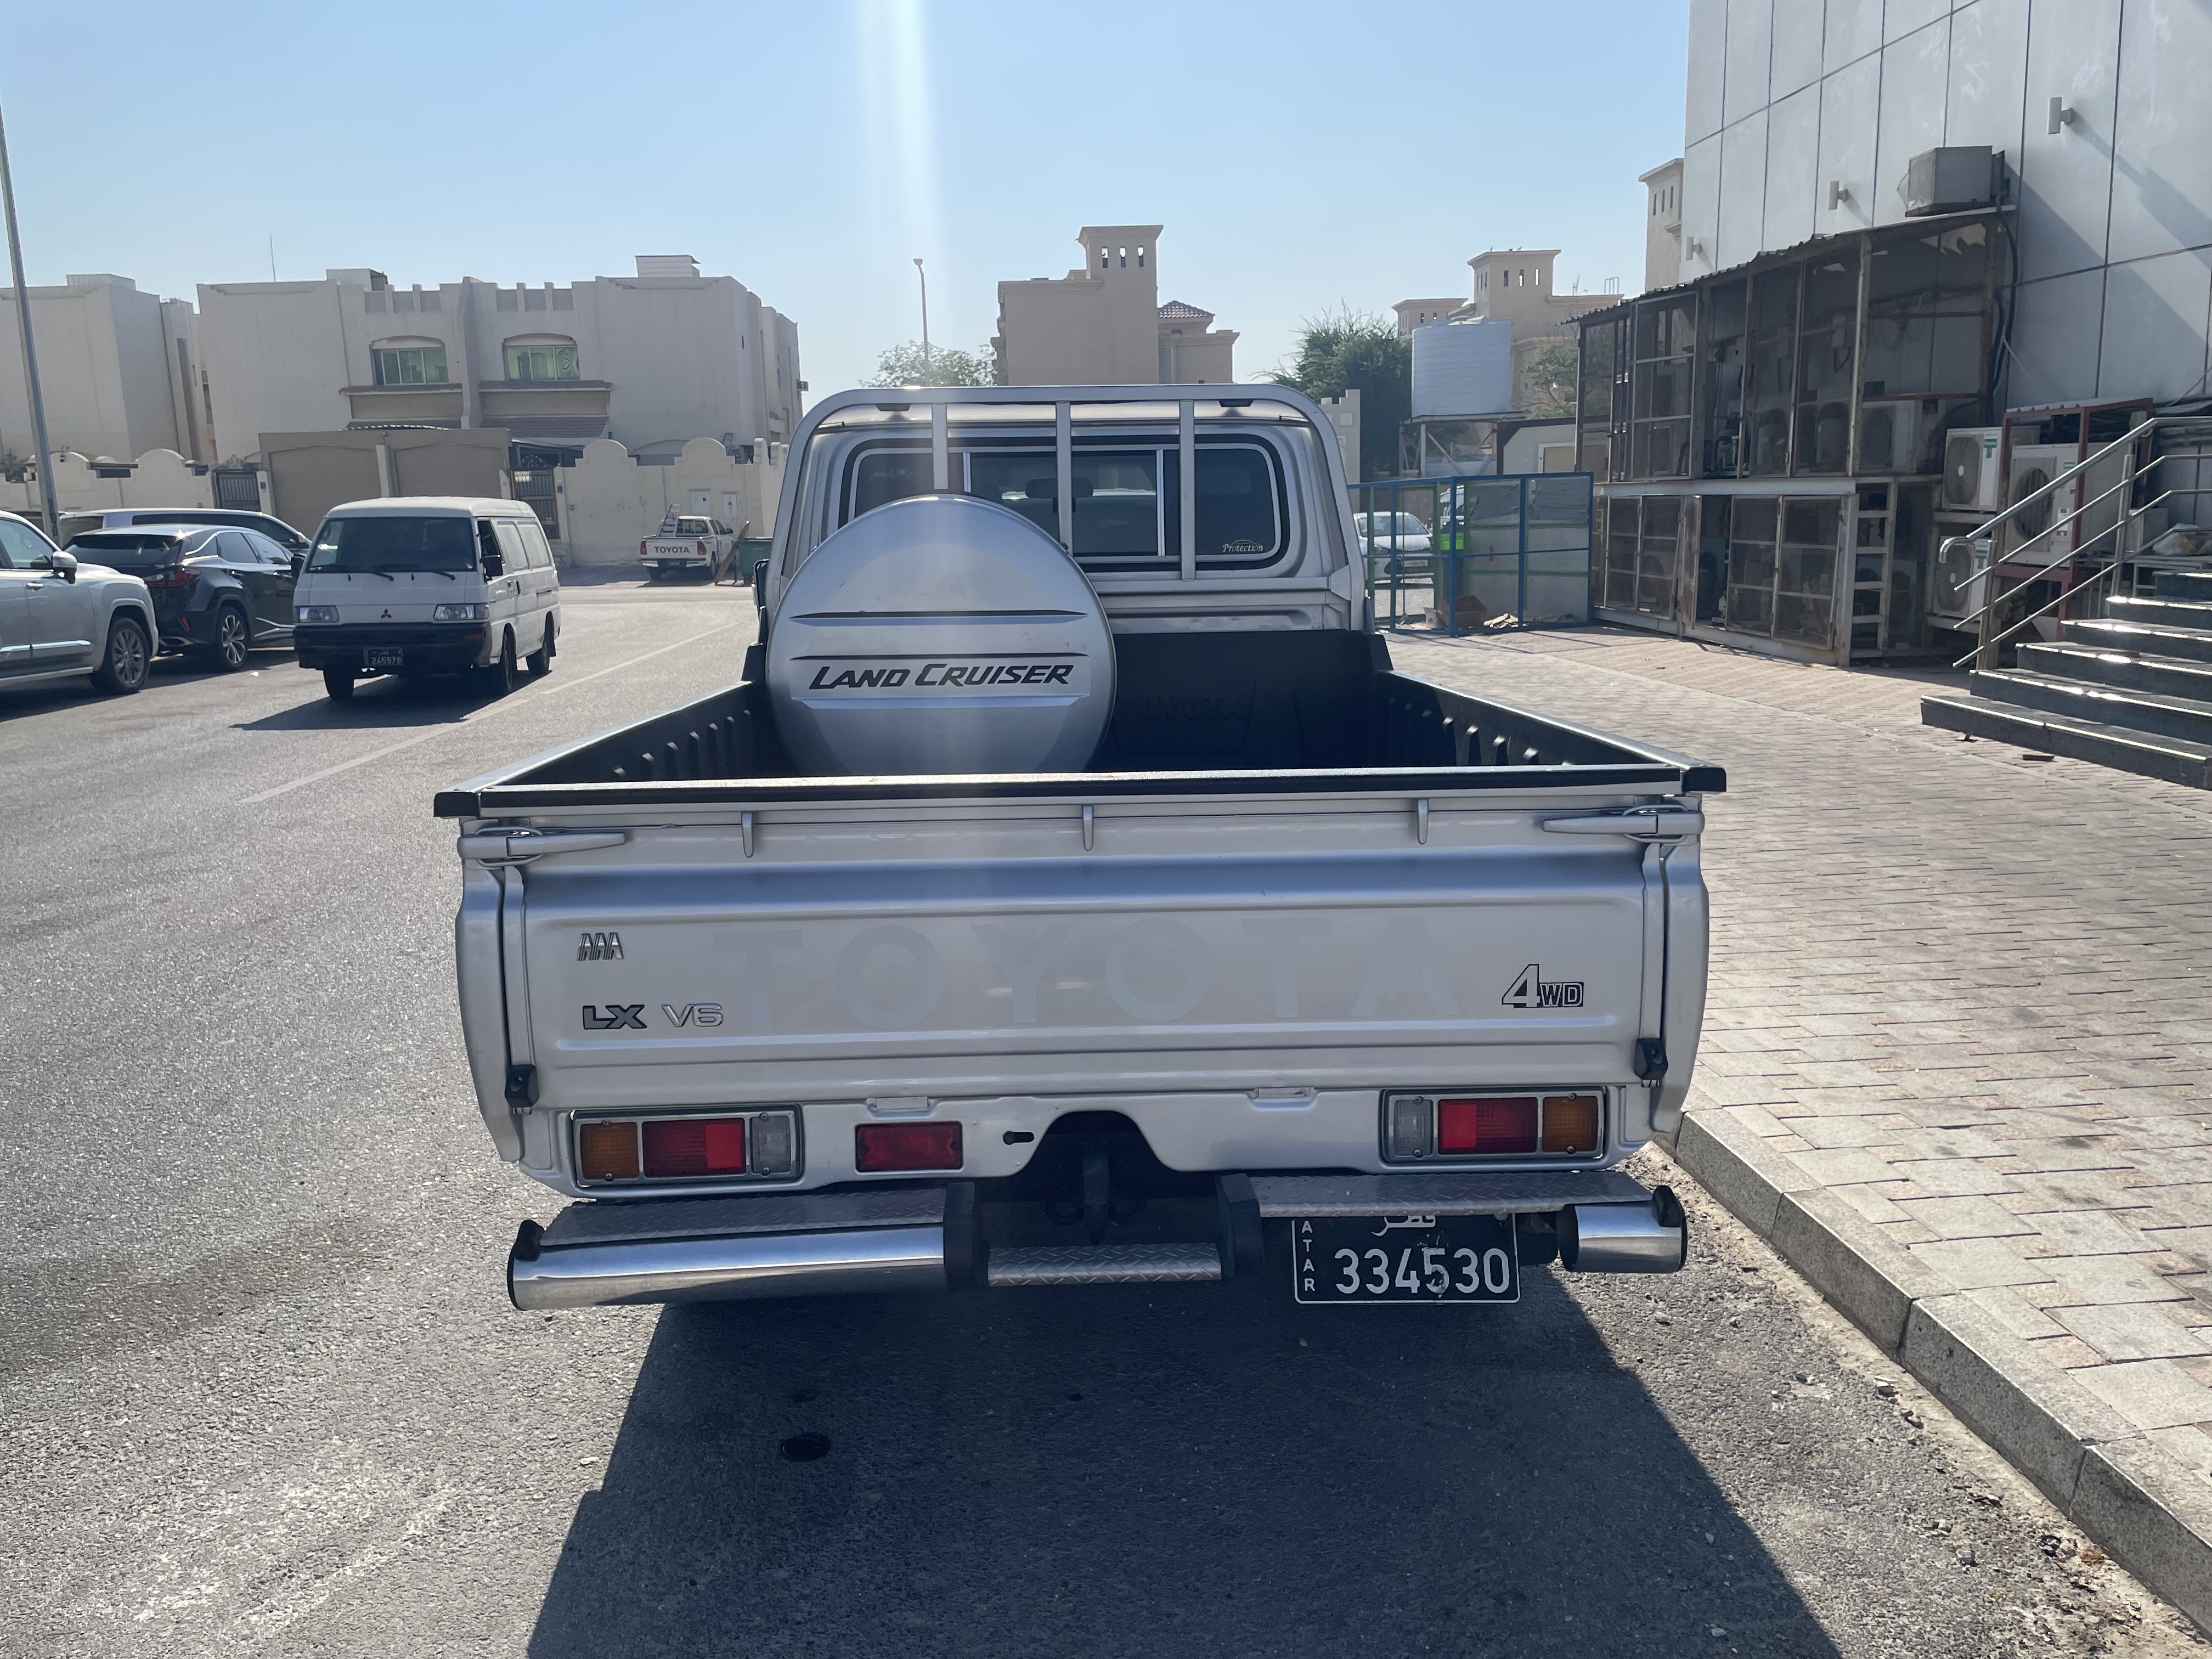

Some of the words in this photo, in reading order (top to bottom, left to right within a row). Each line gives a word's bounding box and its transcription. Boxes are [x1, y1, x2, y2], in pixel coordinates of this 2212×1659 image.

[1222, 544, 1263, 552] Protection
[809, 666, 911, 690] LAND
[915, 663, 1074, 687] CRUISER
[712, 916, 1460, 1029] TOYOTA
[1502, 964, 1584, 1008] 4WD
[582, 1005, 647, 1030] LX
[661, 1003, 724, 1028] V6
[1301, 1220, 1316, 1292] ATAR
[1334, 1248, 1510, 1294] 334530
